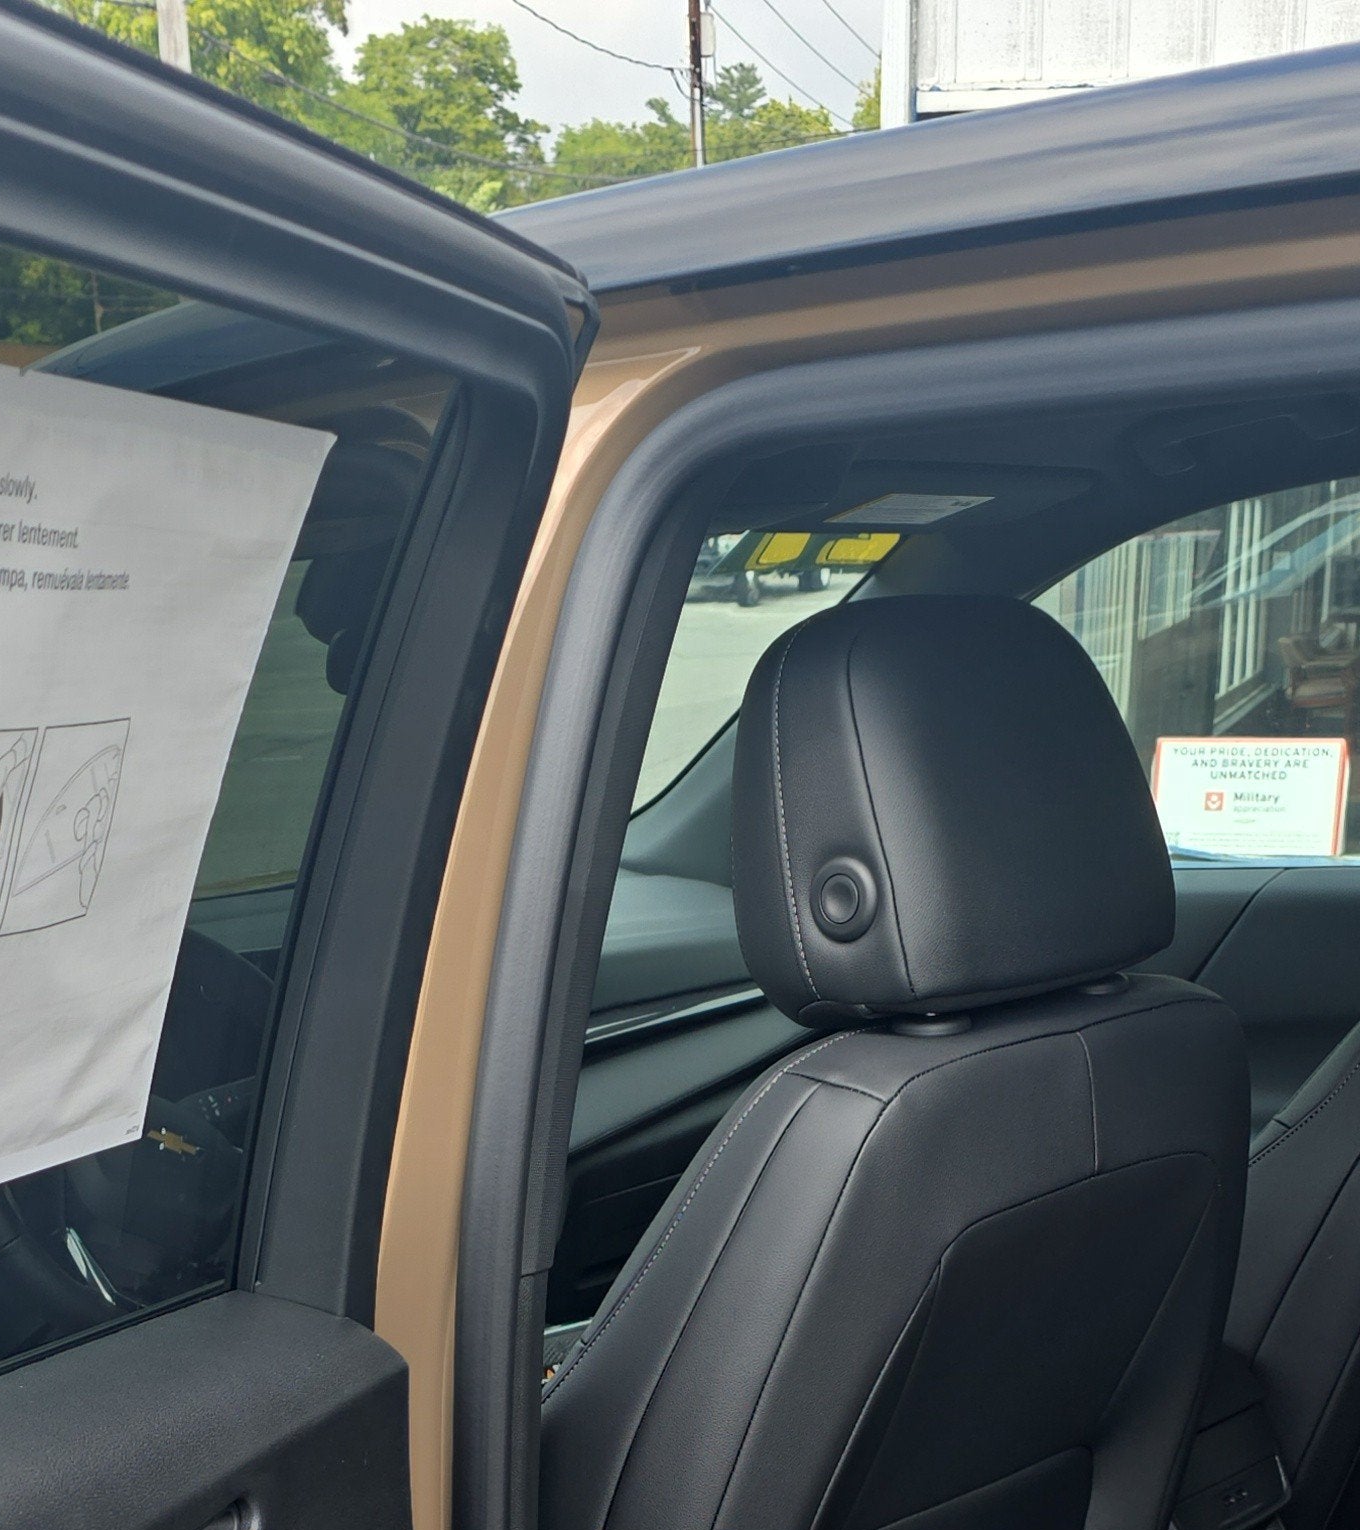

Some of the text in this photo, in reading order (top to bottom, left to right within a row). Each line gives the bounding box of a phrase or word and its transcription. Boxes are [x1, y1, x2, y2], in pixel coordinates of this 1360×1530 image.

[0, 472, 37, 504] slowly.
[1173, 747, 1206, 757] YOUR
[1192, 759, 1310, 768] AND BRAVERY ARE
[1210, 771, 1288, 780] UNMATCHED
[1233, 792, 1280, 805] Military
